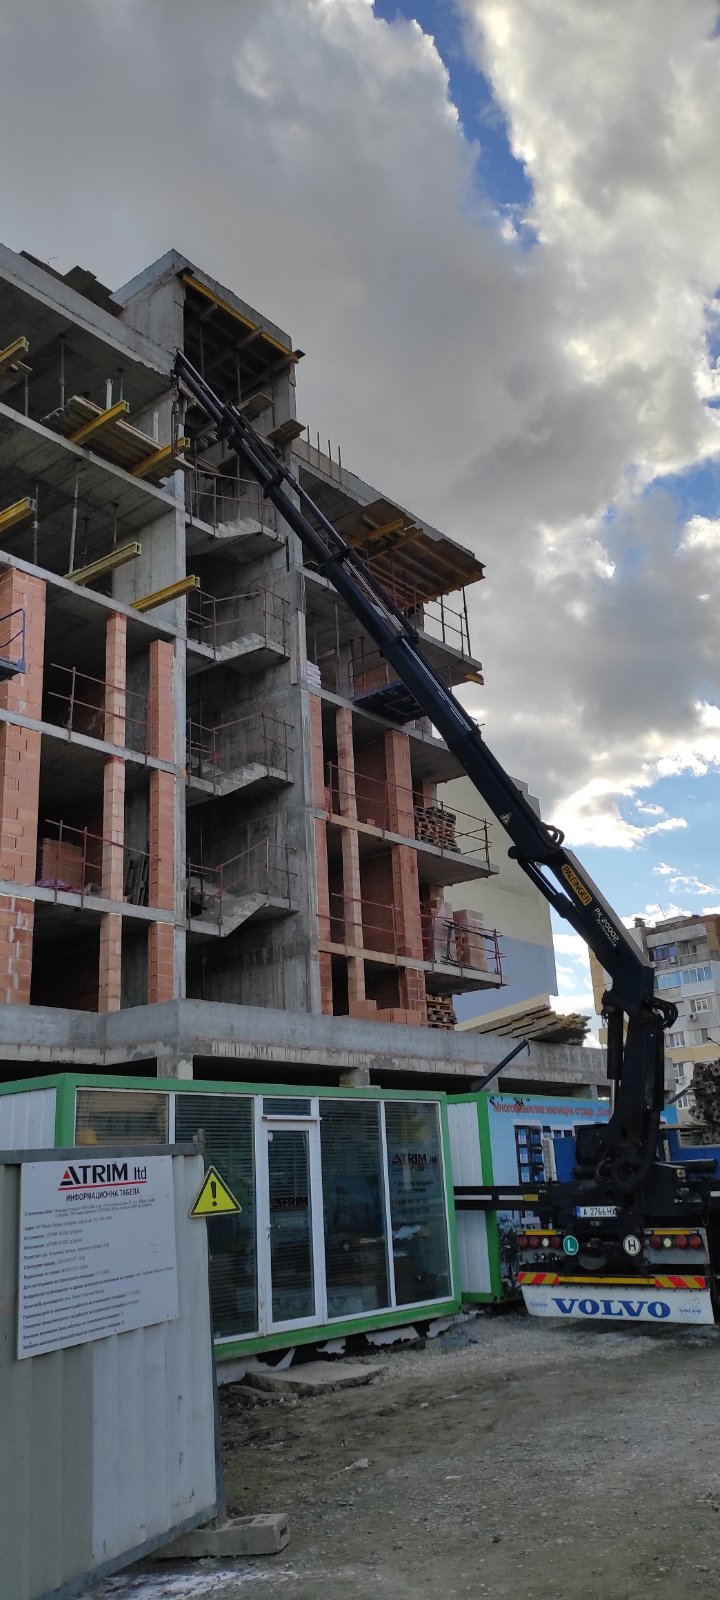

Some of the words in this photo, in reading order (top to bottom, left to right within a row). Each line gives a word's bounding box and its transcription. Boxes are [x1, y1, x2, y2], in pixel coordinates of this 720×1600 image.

[601, 918, 620, 944] 20002
[60, 1163, 128, 1186] ATRIM
[134, 1166, 147, 1180] ltd
[66, 1190, 118, 1202] ИНФОРМАЦИОННА
[119, 1188, 140, 1196] ТАБЕЛА
[551, 1297, 671, 1319] VOLVO
